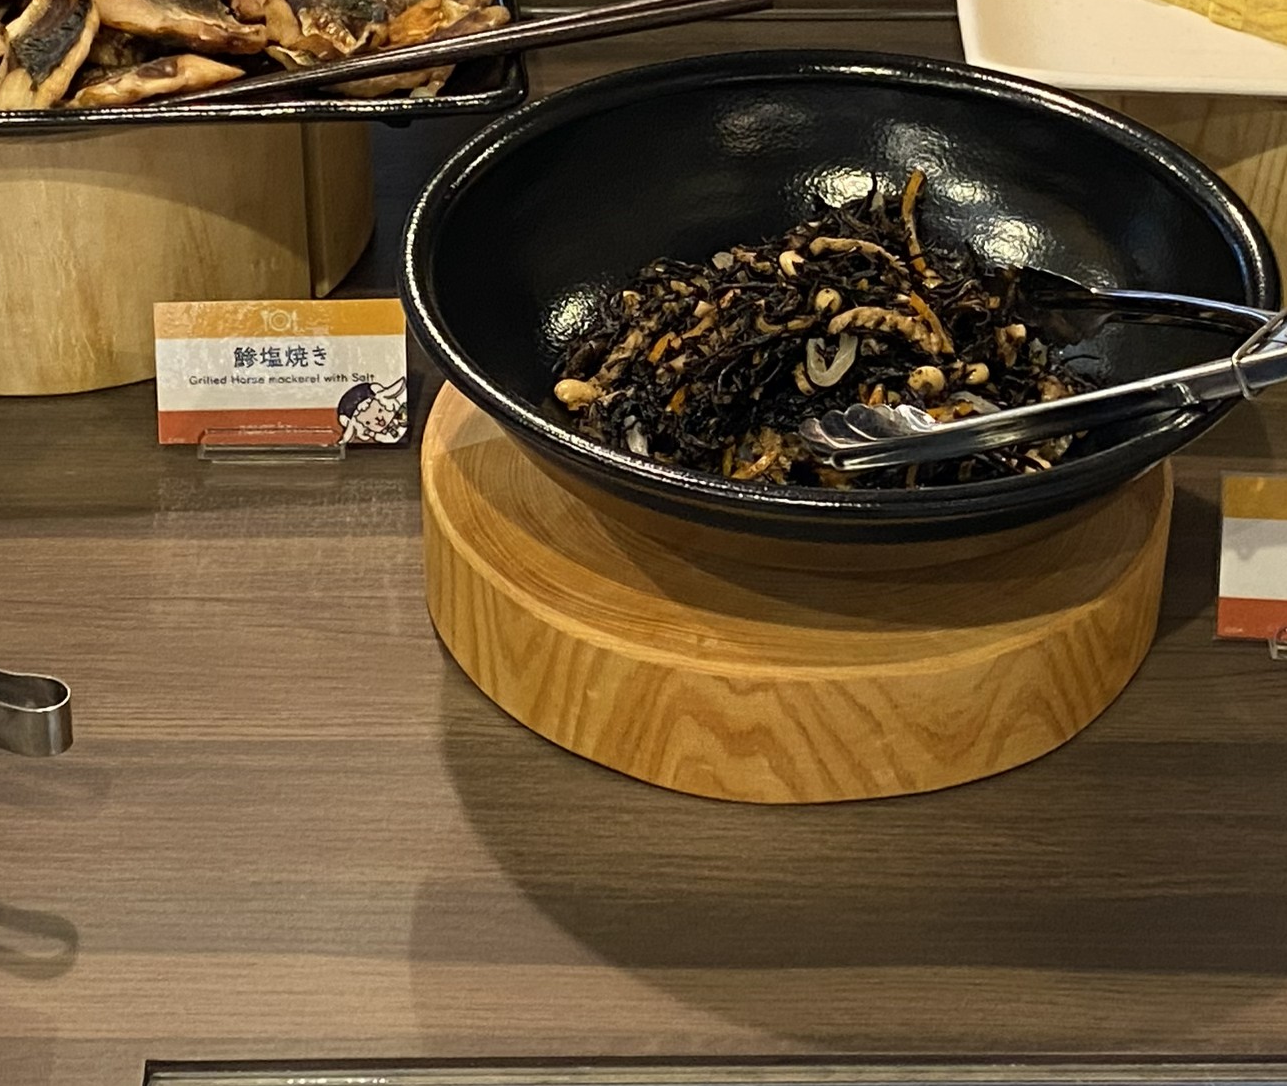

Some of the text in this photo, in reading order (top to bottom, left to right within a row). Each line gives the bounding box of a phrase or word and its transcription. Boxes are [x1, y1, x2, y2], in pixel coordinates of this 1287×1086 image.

[188, 374, 228, 386] Grilled
[230, 374, 265, 385] Horse
[323, 373, 348, 383] with
[351, 372, 375, 383] Salt
